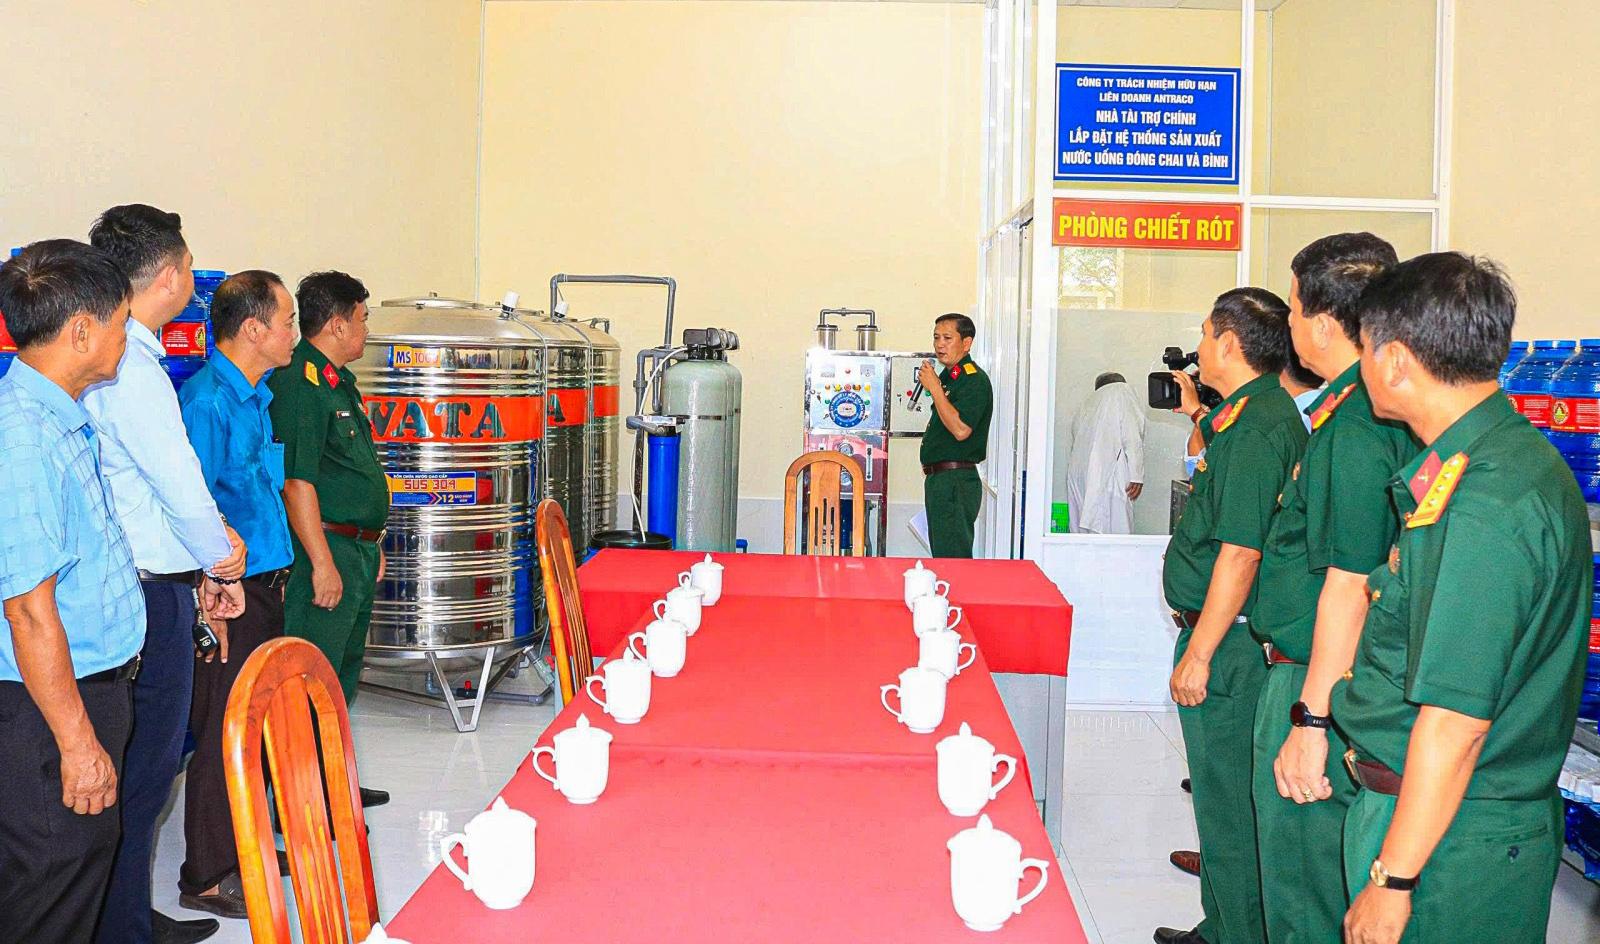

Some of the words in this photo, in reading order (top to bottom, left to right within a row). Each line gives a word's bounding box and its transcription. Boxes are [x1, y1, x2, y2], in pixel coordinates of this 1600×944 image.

[1076, 76, 1101, 88] CÔNG
[1104, 78, 1114, 88] TY
[1116, 77, 1145, 88] TRÁCH
[1147, 78, 1176, 91] NHIỆM
[1178, 79, 1196, 90] HỮU
[1198, 81, 1217, 92] HẠN
[1099, 91, 1119, 102] LIÊN
[1121, 93, 1151, 103] DOANH
[1153, 94, 1194, 104] ANTRACO
[1096, 108, 1118, 123] NHÀ
[1121, 108, 1138, 124] TÀI
[1141, 110, 1161, 127] TRỢ
[1163, 110, 1197, 125] CHÍNH
[1069, 126, 1090, 144] LẮP
[1092, 129, 1113, 146] ĐẶT
[1115, 129, 1129, 147] HỆ
[1132, 128, 1167, 145] THỐNG
[1169, 129, 1192, 146] SẢN
[1194, 129, 1222, 147] XUẤT
[1062, 149, 1092, 165] NƯỚC
[1094, 148, 1124, 165] UỐNG
[1126, 150, 1156, 166] ĐÓNG
[1158, 153, 1184, 167] CHAI
[1186, 152, 1200, 167] VÀ
[1202, 152, 1229, 168] BÌNH
[1059, 210, 1128, 239] PHÒNG
[1134, 212, 1190, 240] CHIẾT
[1196, 215, 1234, 242] RÓT
[396, 351, 411, 364] MS
[404, 479, 428, 490] SUS
[432, 479, 456, 490] 304
[442, 494, 455, 503] 12
